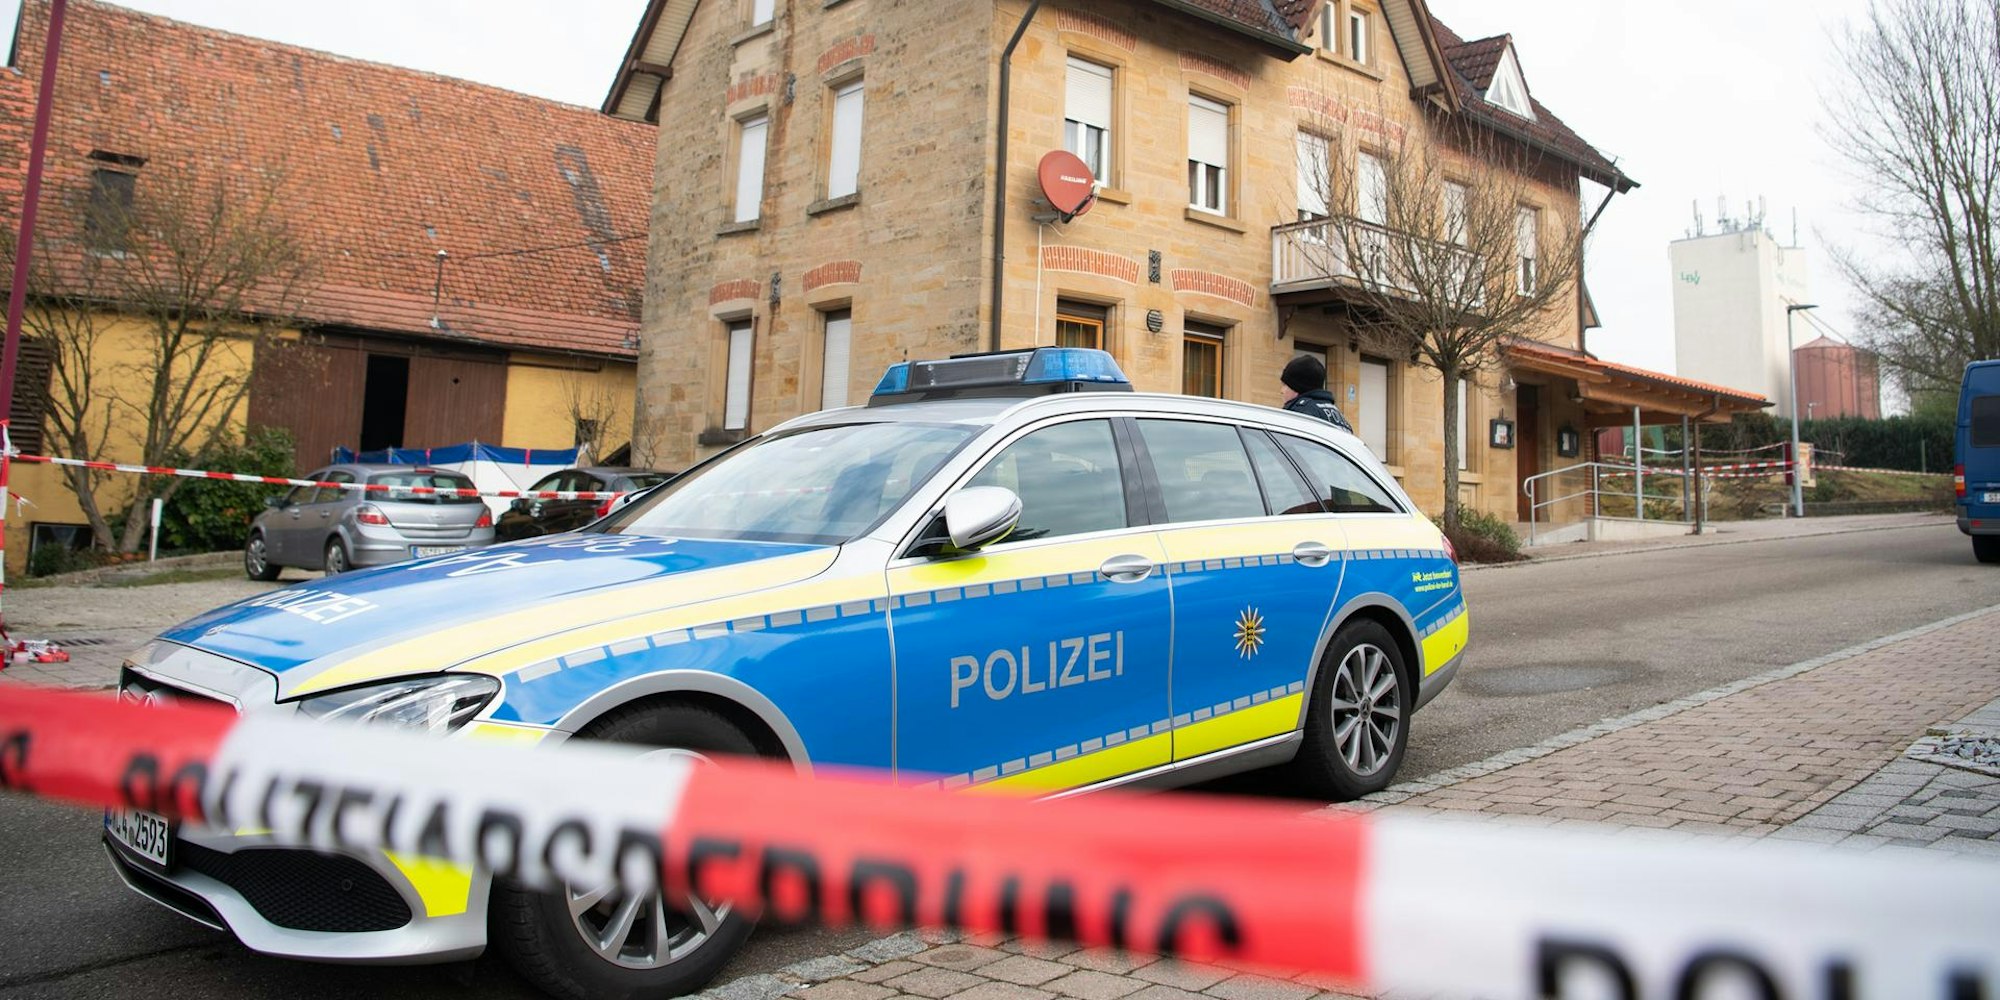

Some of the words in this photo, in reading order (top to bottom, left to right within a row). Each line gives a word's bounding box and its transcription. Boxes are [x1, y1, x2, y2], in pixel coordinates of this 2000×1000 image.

[232, 589, 379, 625] POLIZEI
[950, 630, 1124, 709] POLIZEI
[135, 812, 166, 859] 2593
